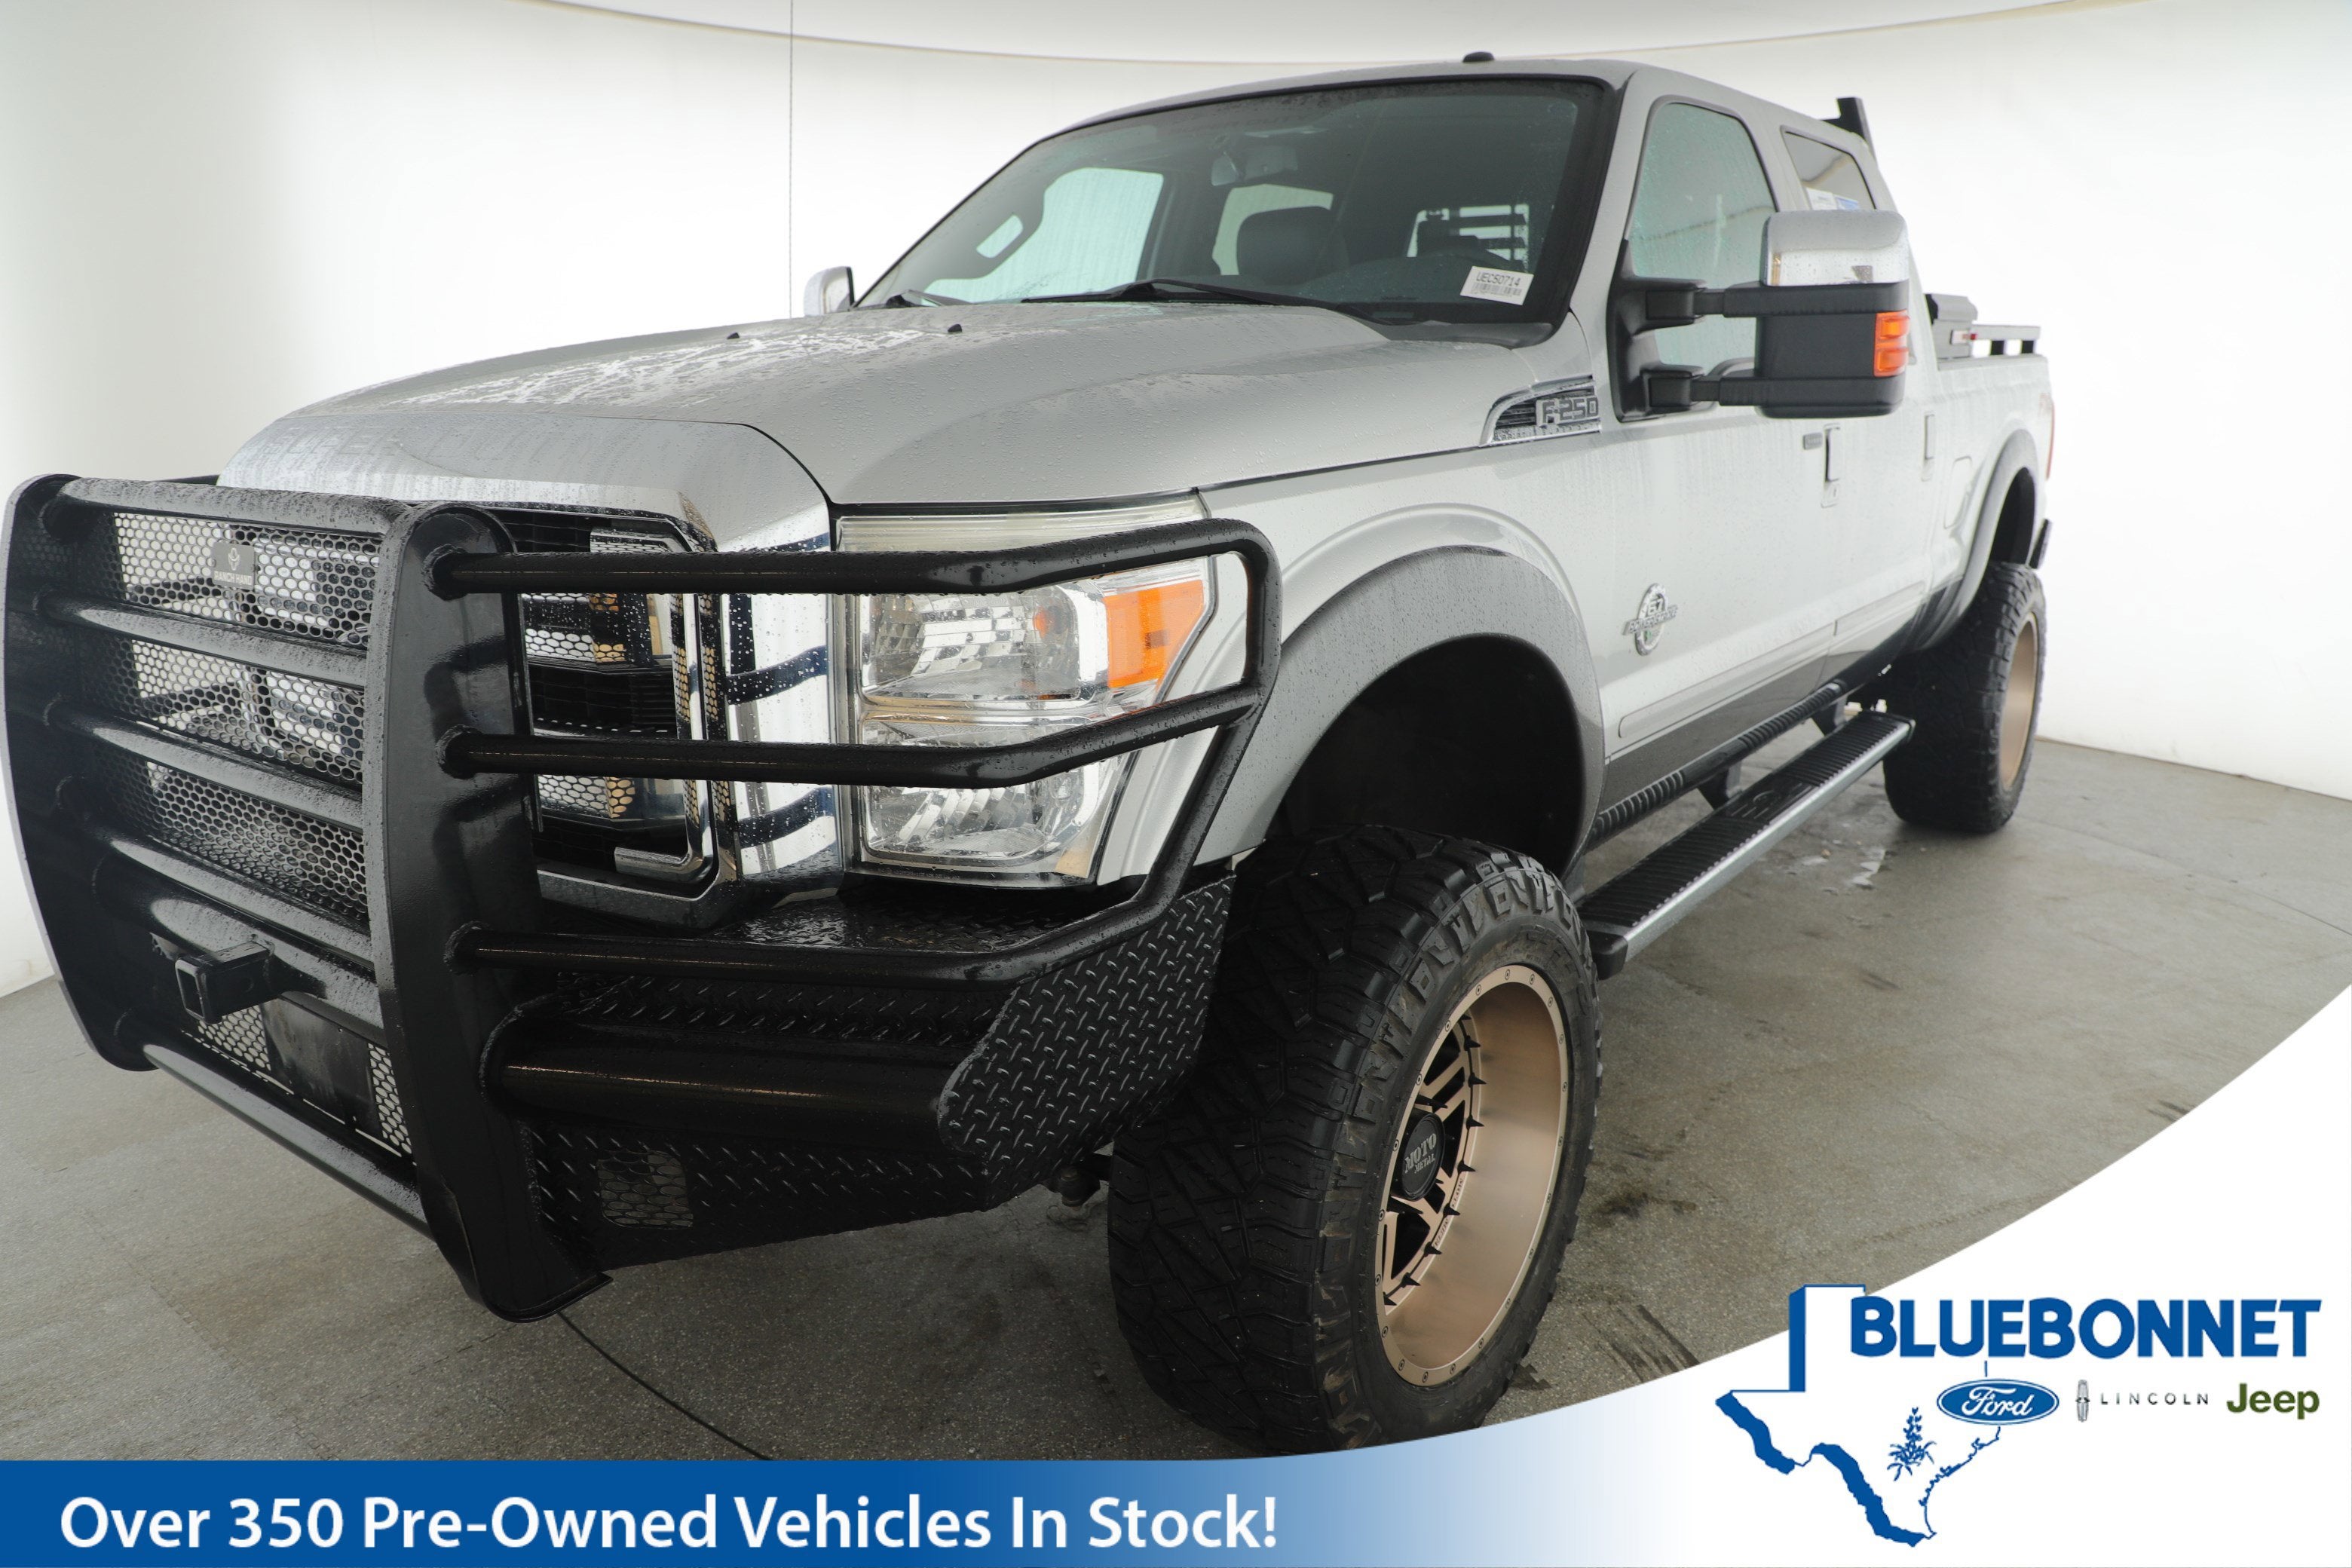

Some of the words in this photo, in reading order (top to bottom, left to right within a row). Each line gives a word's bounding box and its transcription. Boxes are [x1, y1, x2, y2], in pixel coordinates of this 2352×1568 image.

[1475, 271, 1521, 286] UEC50714
[1537, 396, 1599, 424] F-250
[1404, 1133, 1437, 1174] MOTO
[1414, 1153, 1435, 1174] METAL
